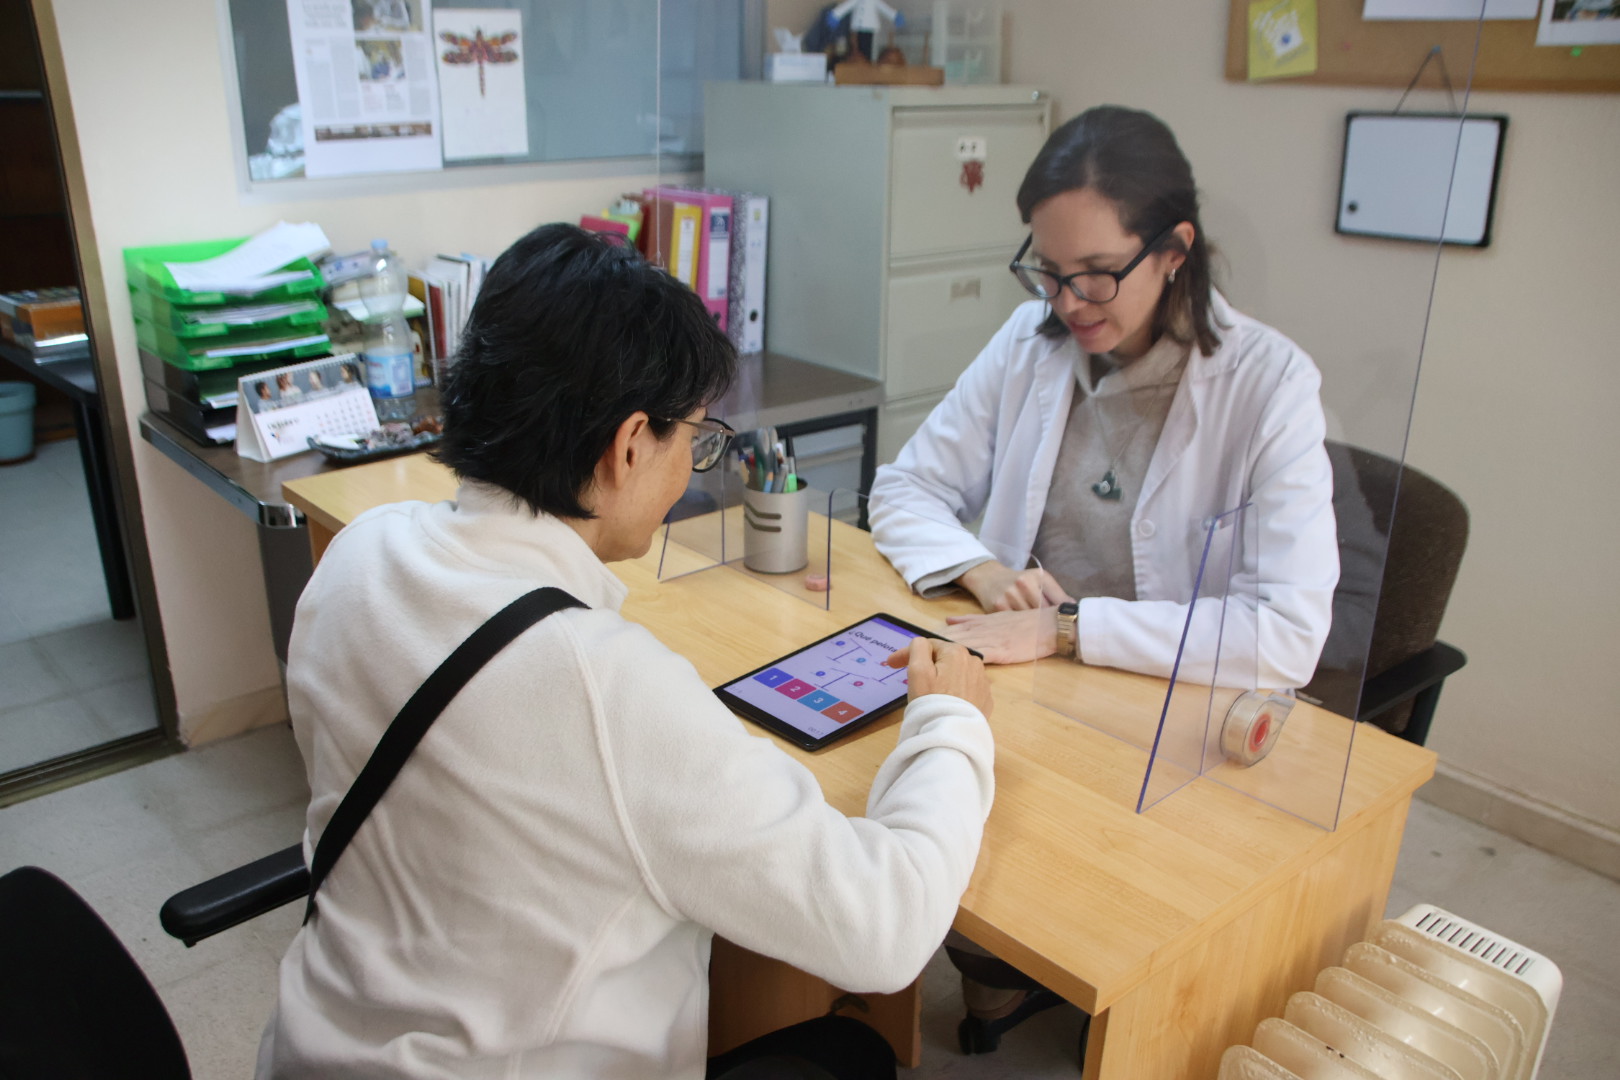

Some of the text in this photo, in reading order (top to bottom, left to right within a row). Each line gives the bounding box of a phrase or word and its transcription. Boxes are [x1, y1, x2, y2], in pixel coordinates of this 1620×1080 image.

[869, 639, 898, 653] pelota
[769, 674, 779, 682] 1
[789, 685, 802, 693] 2
